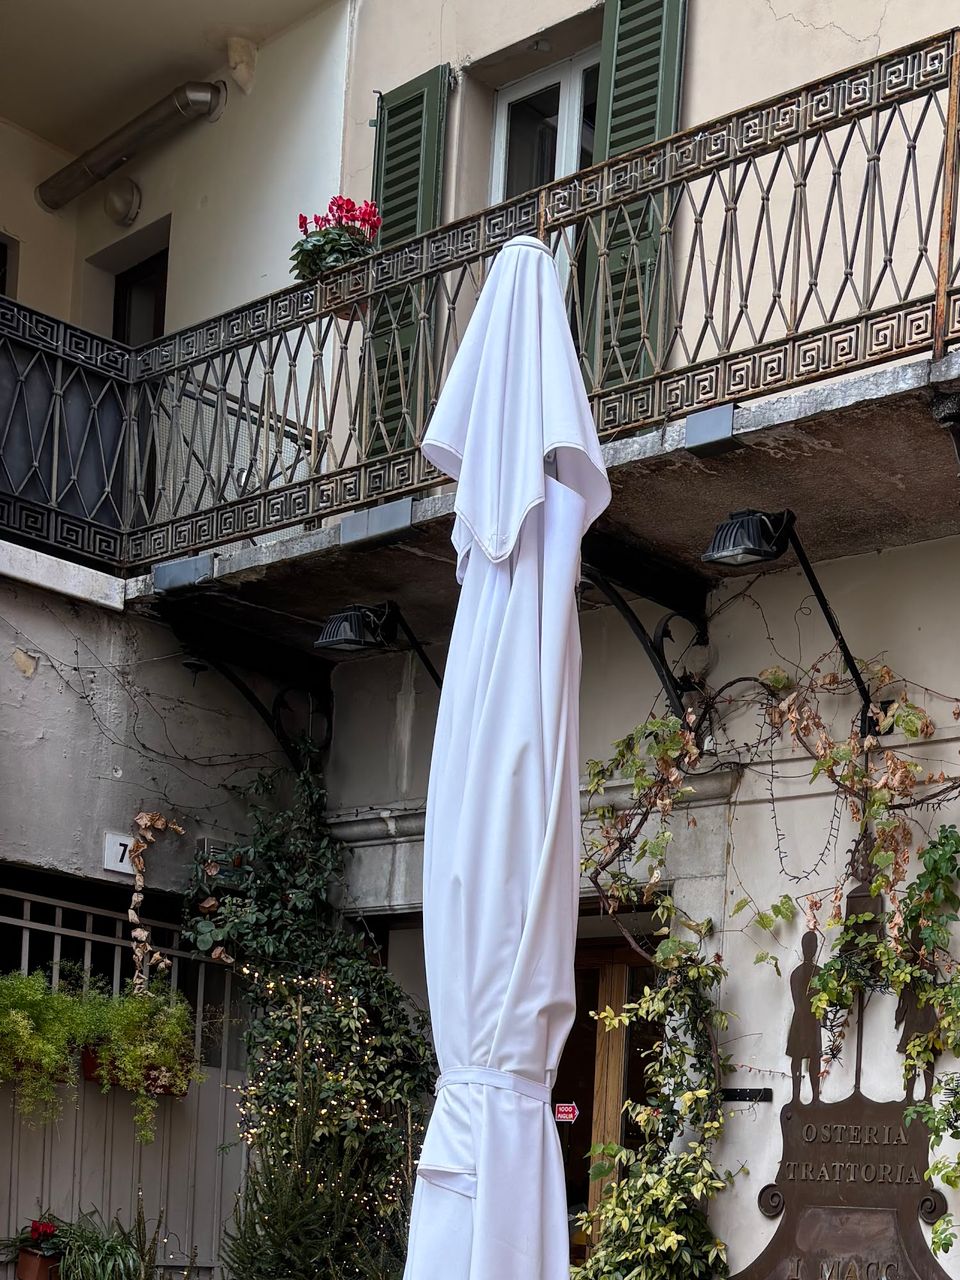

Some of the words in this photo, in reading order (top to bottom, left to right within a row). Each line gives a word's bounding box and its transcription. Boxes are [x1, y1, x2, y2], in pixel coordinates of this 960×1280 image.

[119, 842, 129, 863] 7
[802, 1123, 909, 1146] OSTERIA
[786, 1161, 922, 1185] TRATTORIA
